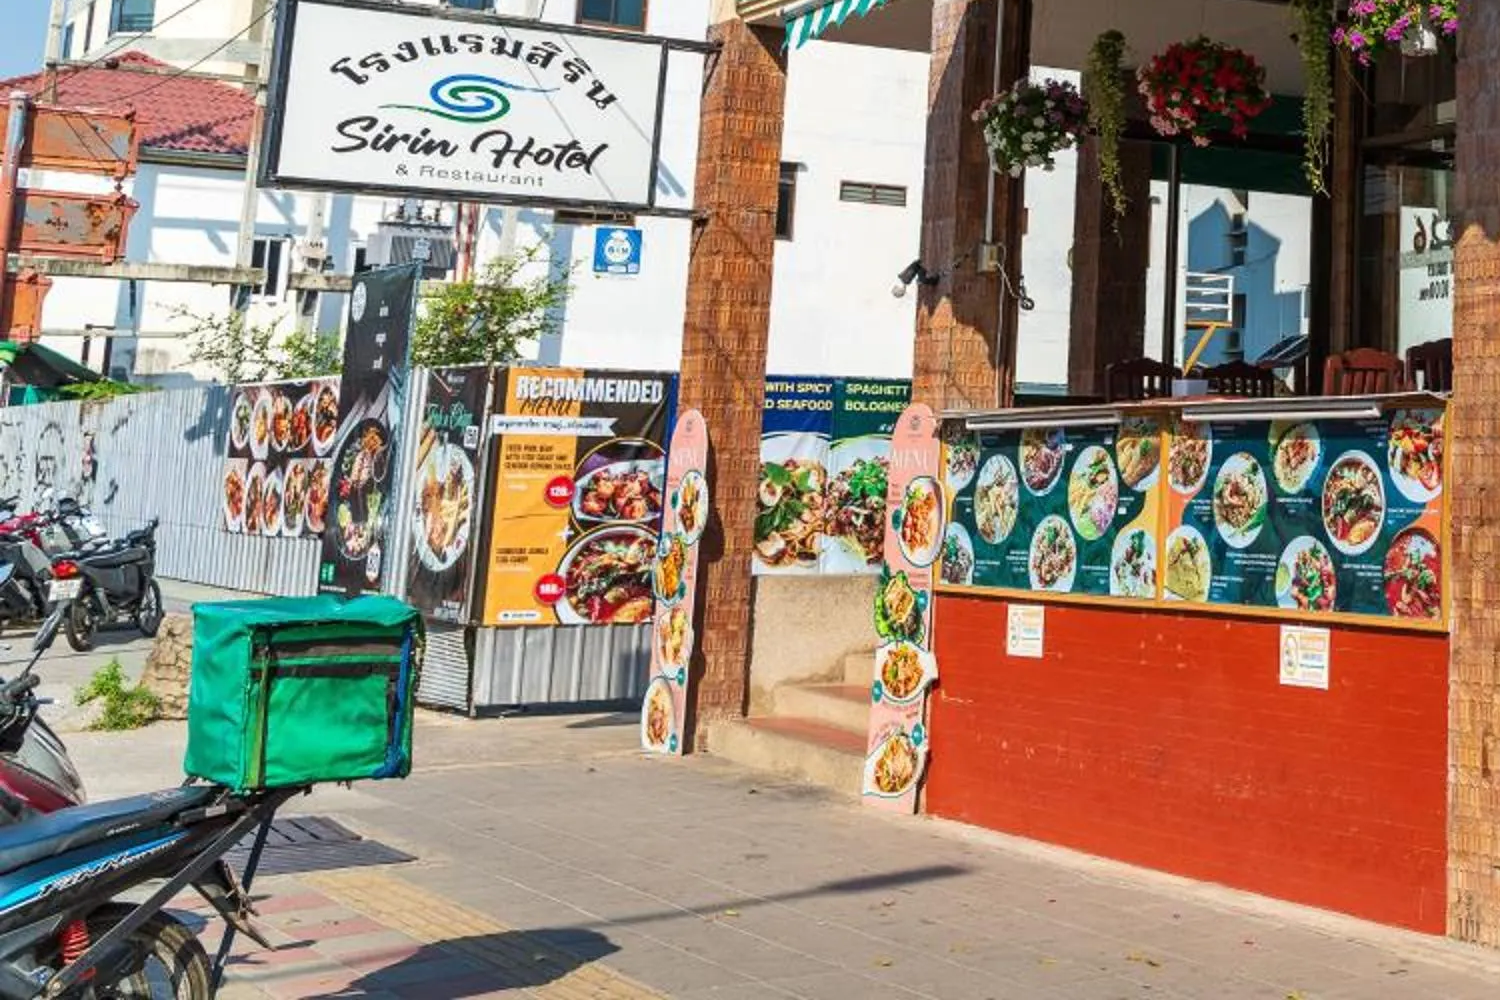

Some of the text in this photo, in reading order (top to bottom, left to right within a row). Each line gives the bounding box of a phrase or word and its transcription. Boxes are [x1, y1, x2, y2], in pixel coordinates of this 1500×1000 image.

[331, 115, 609, 175] Sirin Hotel
[395, 163, 545, 188] & Restaurant
[516, 375, 664, 404] RECOMMENDED
[797, 383, 833, 394] SPICY
[845, 383, 909, 396] SPAGHETT
[519, 397, 574, 417] MENU
[777, 400, 834, 411] SEAFOOD
